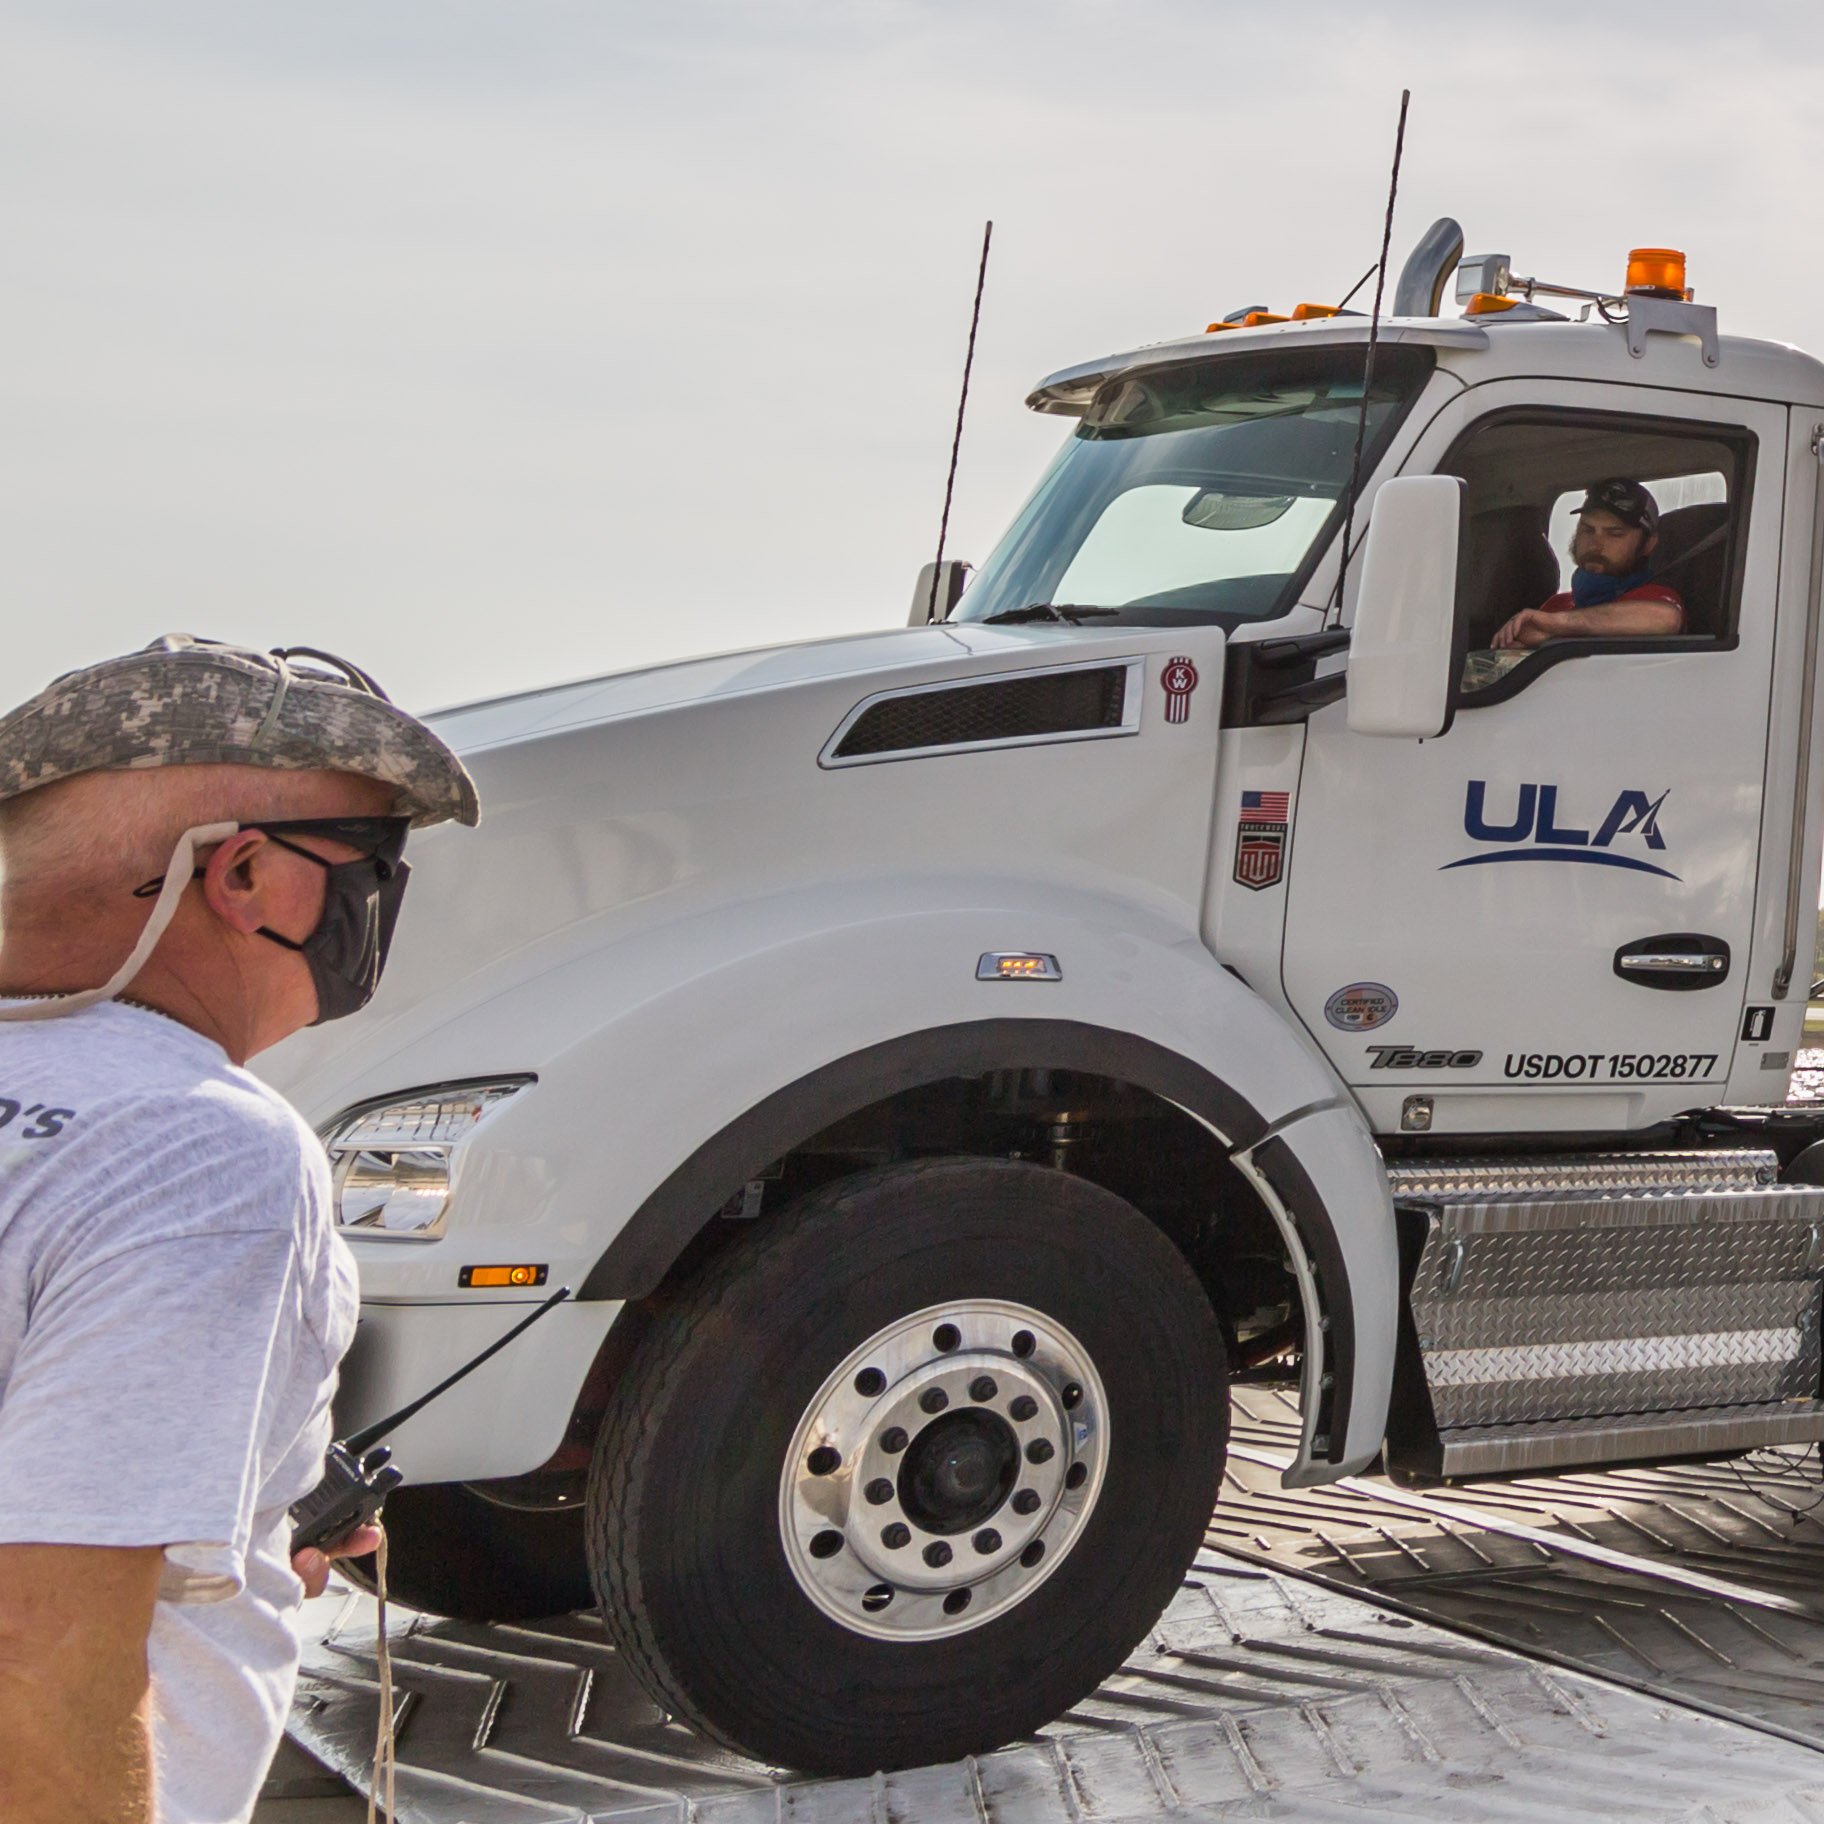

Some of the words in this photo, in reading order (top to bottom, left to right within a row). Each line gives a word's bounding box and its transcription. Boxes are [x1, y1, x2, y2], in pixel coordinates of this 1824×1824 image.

[1464, 780, 1671, 850] ULA
[1335, 1006, 1365, 1014] CLEAN
[1368, 1005, 1387, 1013] IDLE
[1340, 998, 1385, 1006] CERTIFIED
[1366, 1045, 1483, 1069] T880
[1504, 1054, 1604, 1079] USDOT
[1608, 1054, 1719, 1078] 1502877
